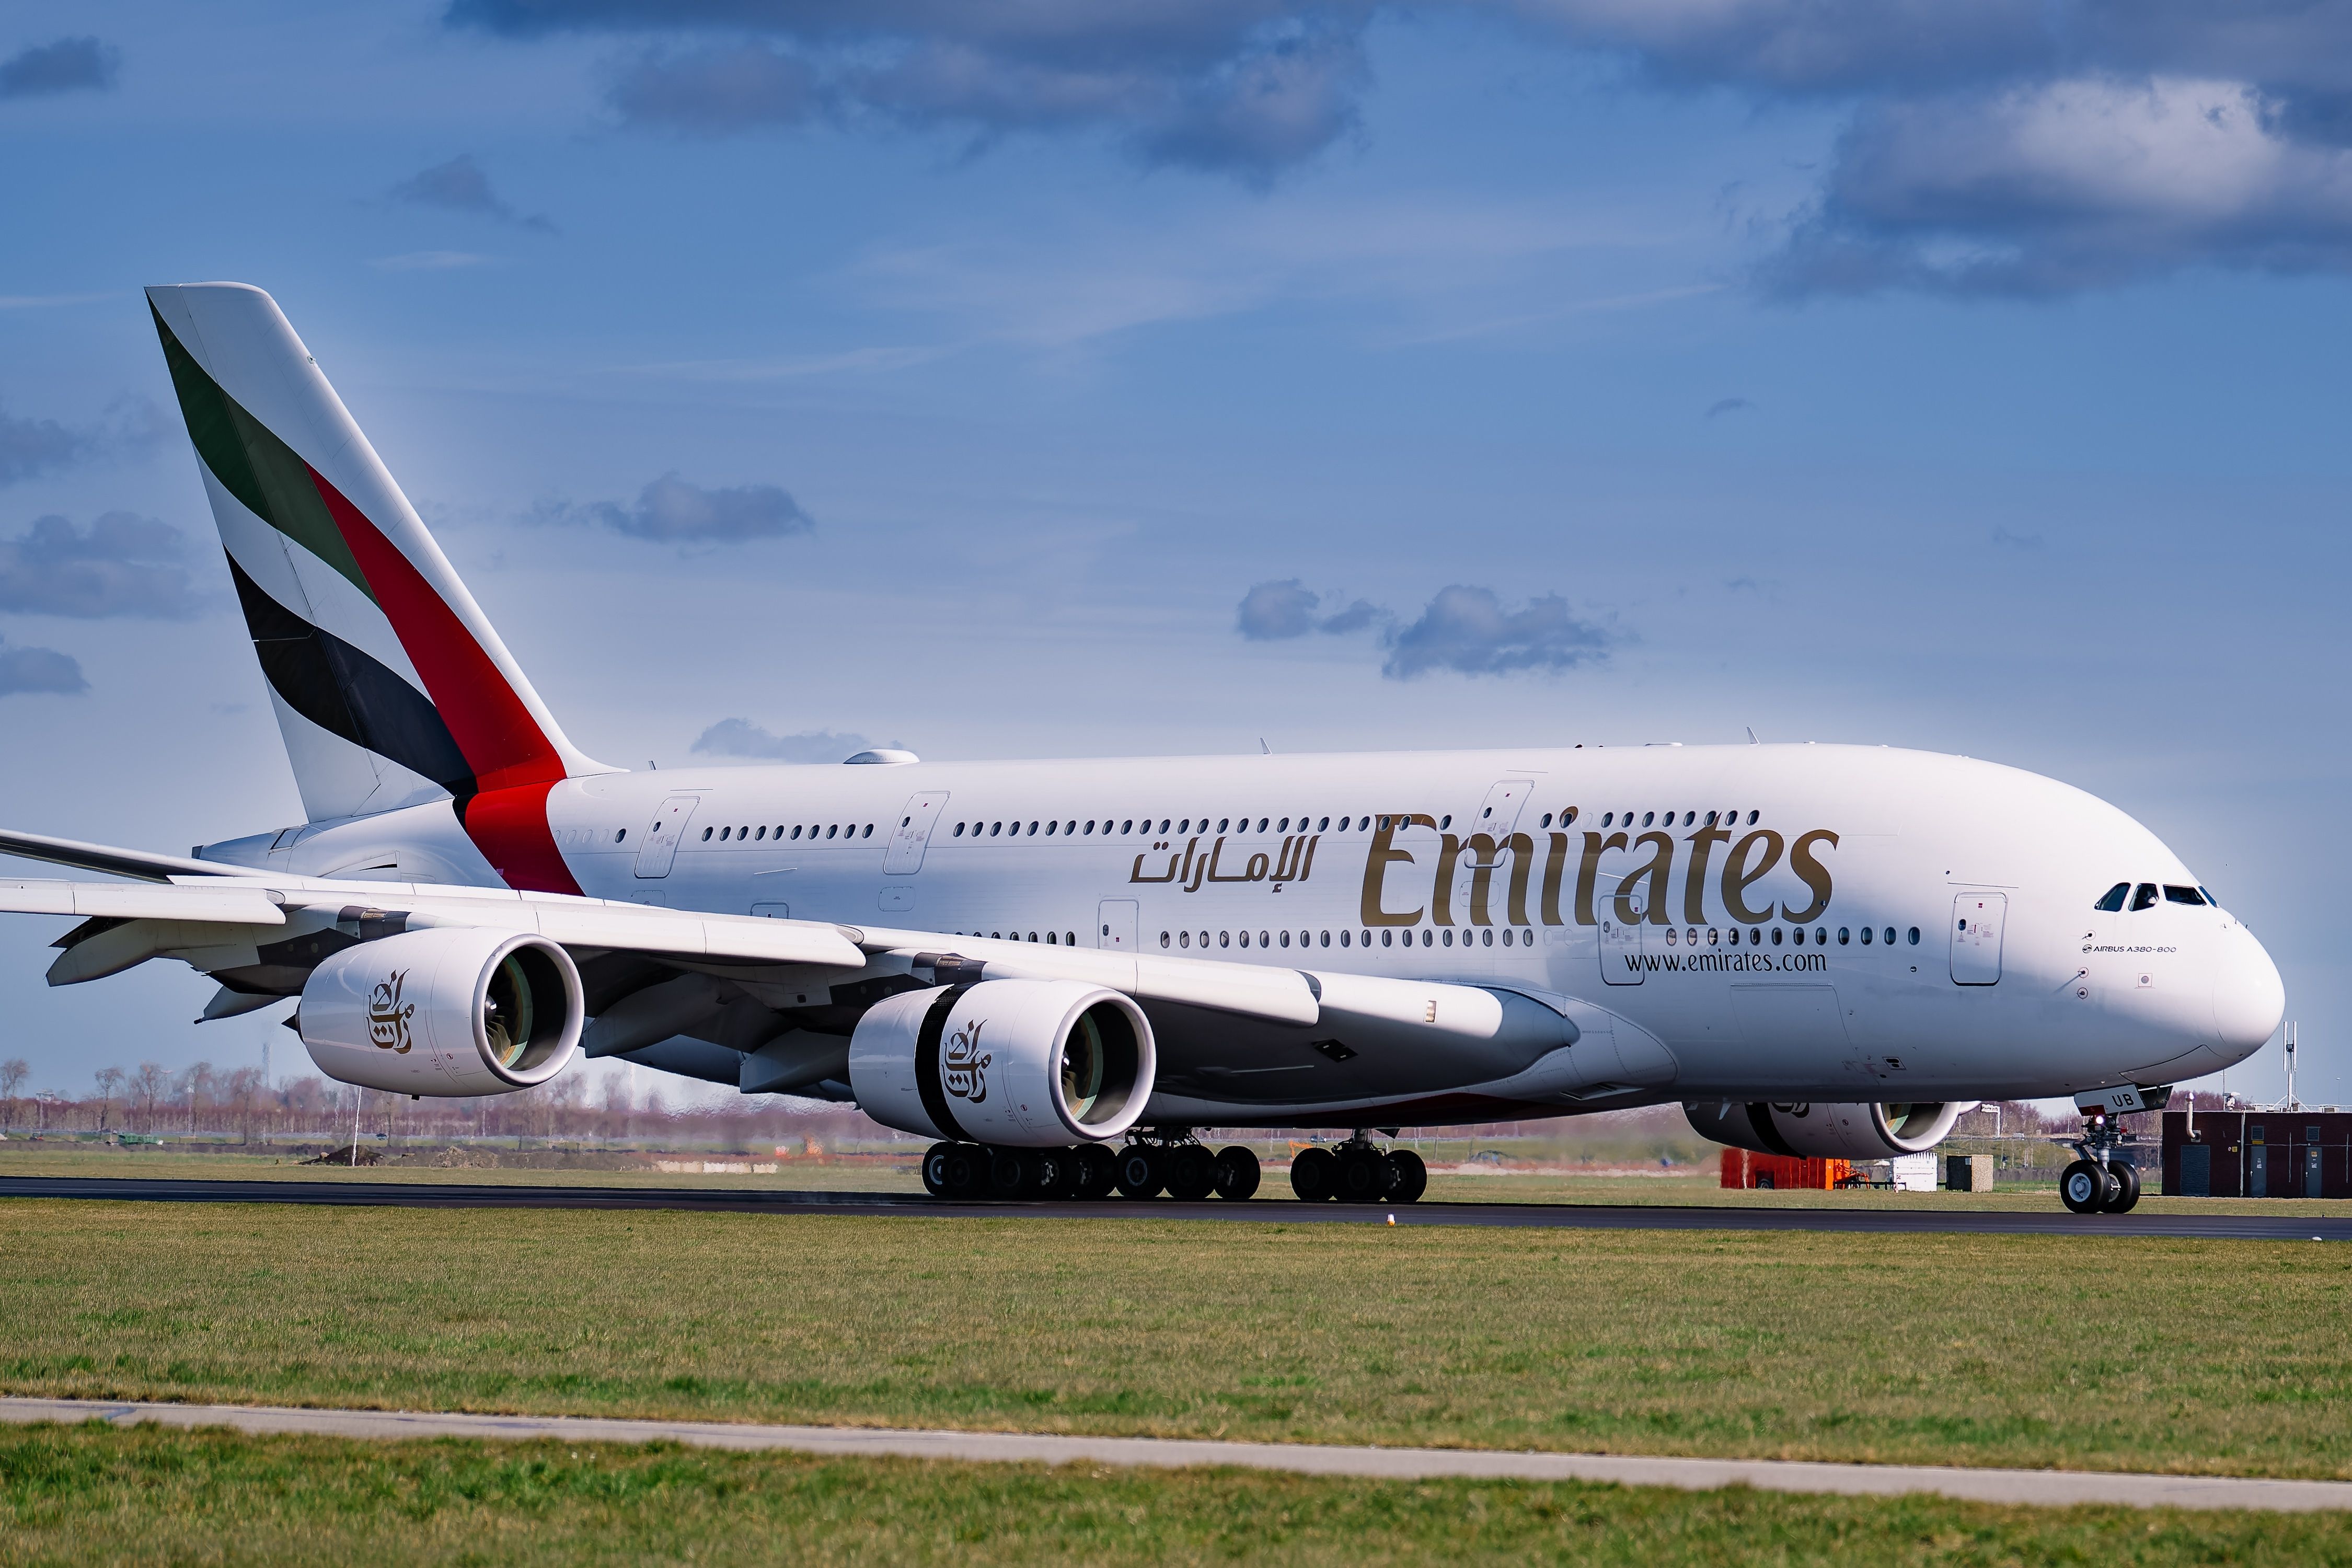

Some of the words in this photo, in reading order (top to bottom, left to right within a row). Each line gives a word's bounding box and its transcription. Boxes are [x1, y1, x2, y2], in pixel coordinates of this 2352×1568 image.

[1127, 835, 1321, 893] الإمارات
[1361, 805, 1840, 927] Emirates
[1624, 948, 1827, 972] www.emirates.com
[2111, 1093, 2134, 1107] UB
